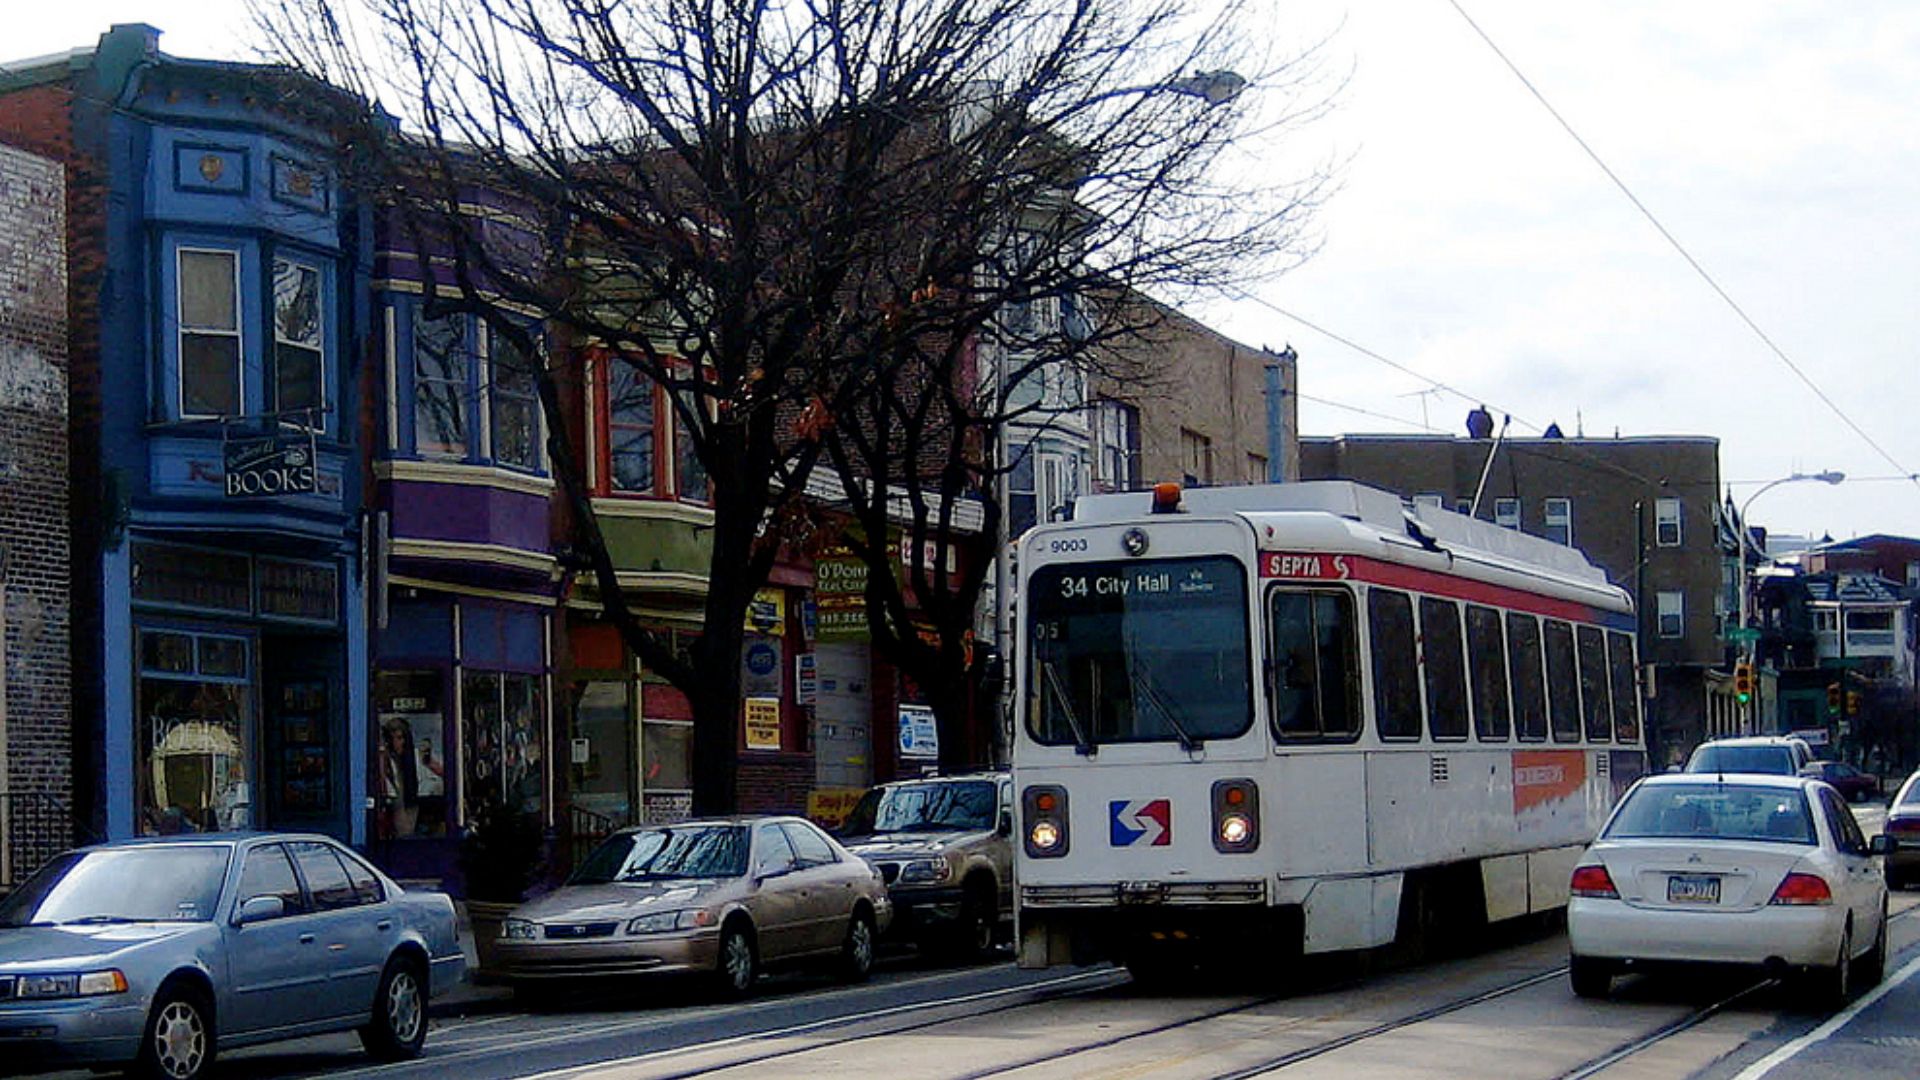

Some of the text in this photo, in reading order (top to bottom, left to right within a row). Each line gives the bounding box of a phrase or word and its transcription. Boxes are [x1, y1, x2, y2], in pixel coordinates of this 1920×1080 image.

[226, 466, 313, 495] BOOKS
[1051, 539, 1088, 553] 9003
[1270, 555, 1321, 577] SEPTA
[1060, 573, 1170, 599] 34 City Hall
